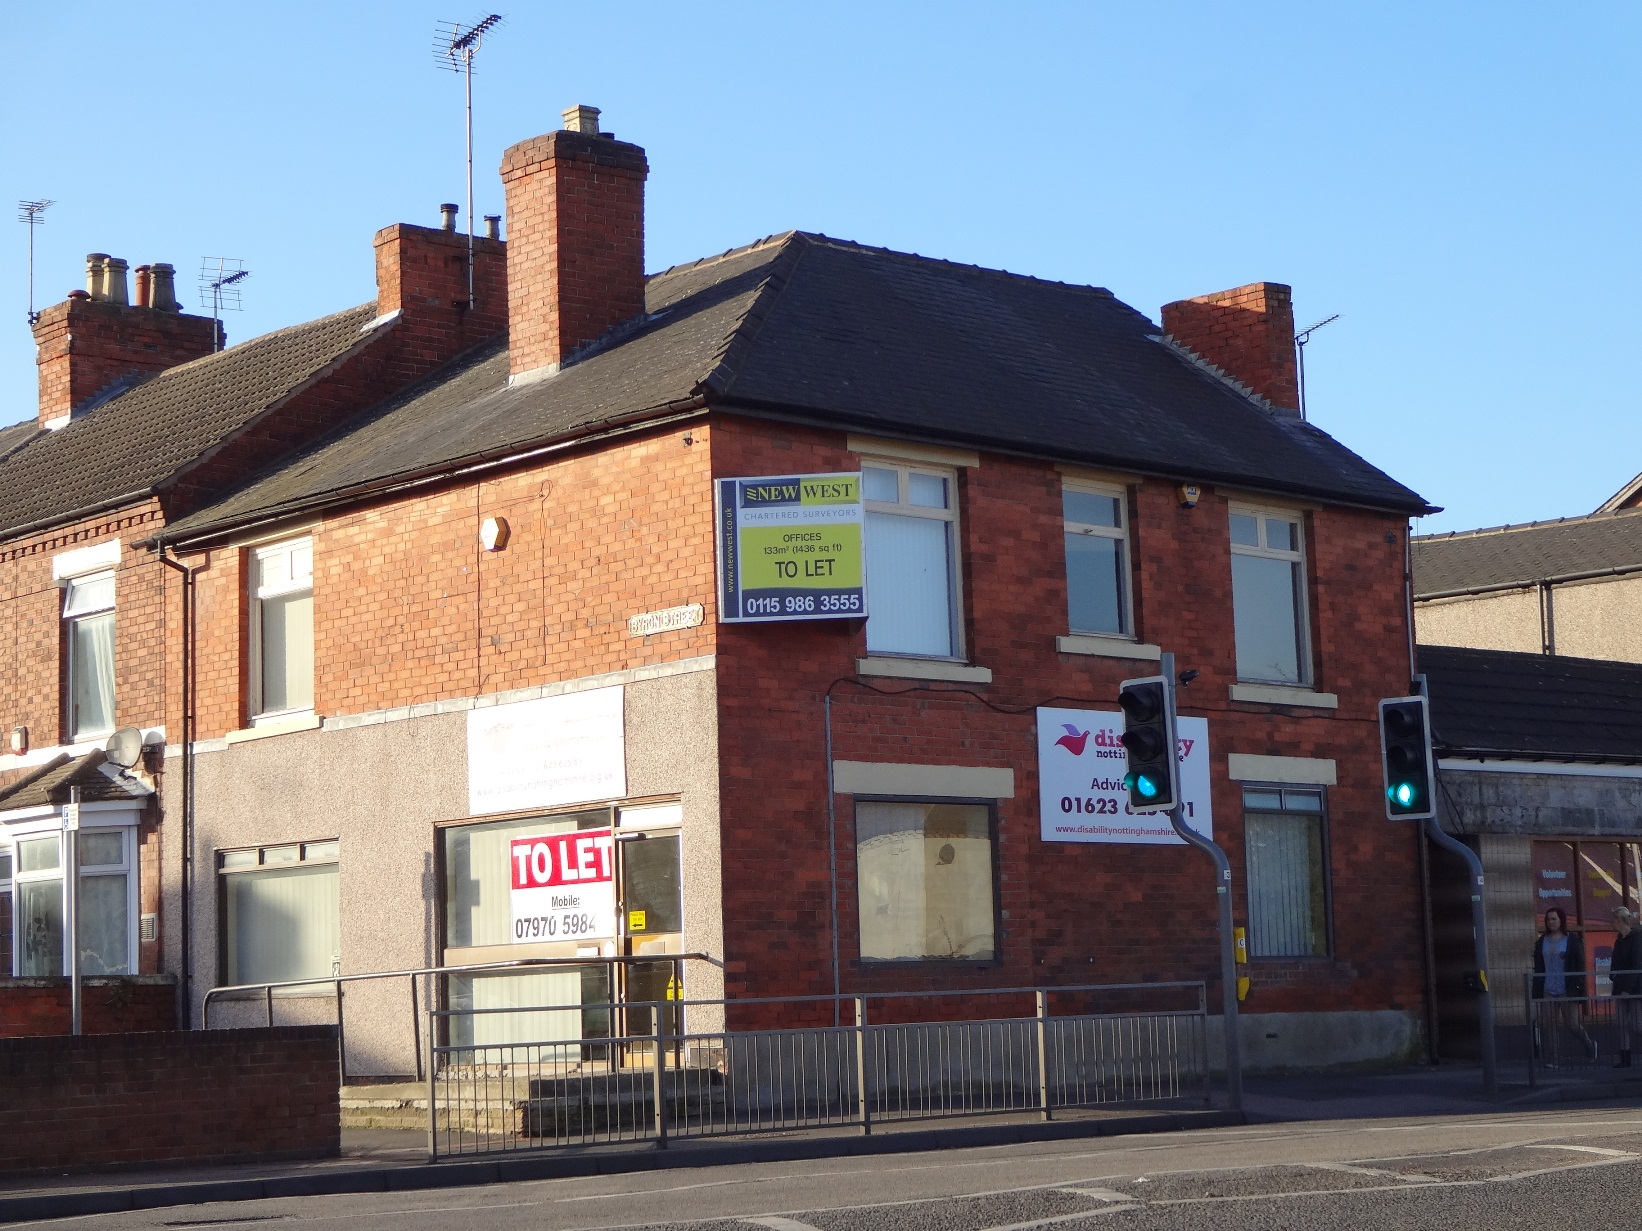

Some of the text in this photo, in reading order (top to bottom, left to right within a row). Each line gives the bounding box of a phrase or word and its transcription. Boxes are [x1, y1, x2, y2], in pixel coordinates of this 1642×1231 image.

[757, 483, 853, 501] NEW WEST
[744, 509, 857, 520] CHARTERED SURVEYORS
[783, 532, 822, 542] OFFICES
[724, 507, 734, 594] www.newwest.co.uk
[792, 545, 816, 555] (1436
[818, 545, 830, 553] sq
[832, 543, 842, 552] ft)
[775, 558, 836, 578] TO LET
[747, 594, 860, 614] 0115 986 3555
[1091, 777, 1127, 791] Advic
[1060, 796, 1119, 814] 01623
[512, 835, 612, 885] TO LET
[551, 894, 580, 908] Mobile:
[515, 915, 557, 938] 07970
